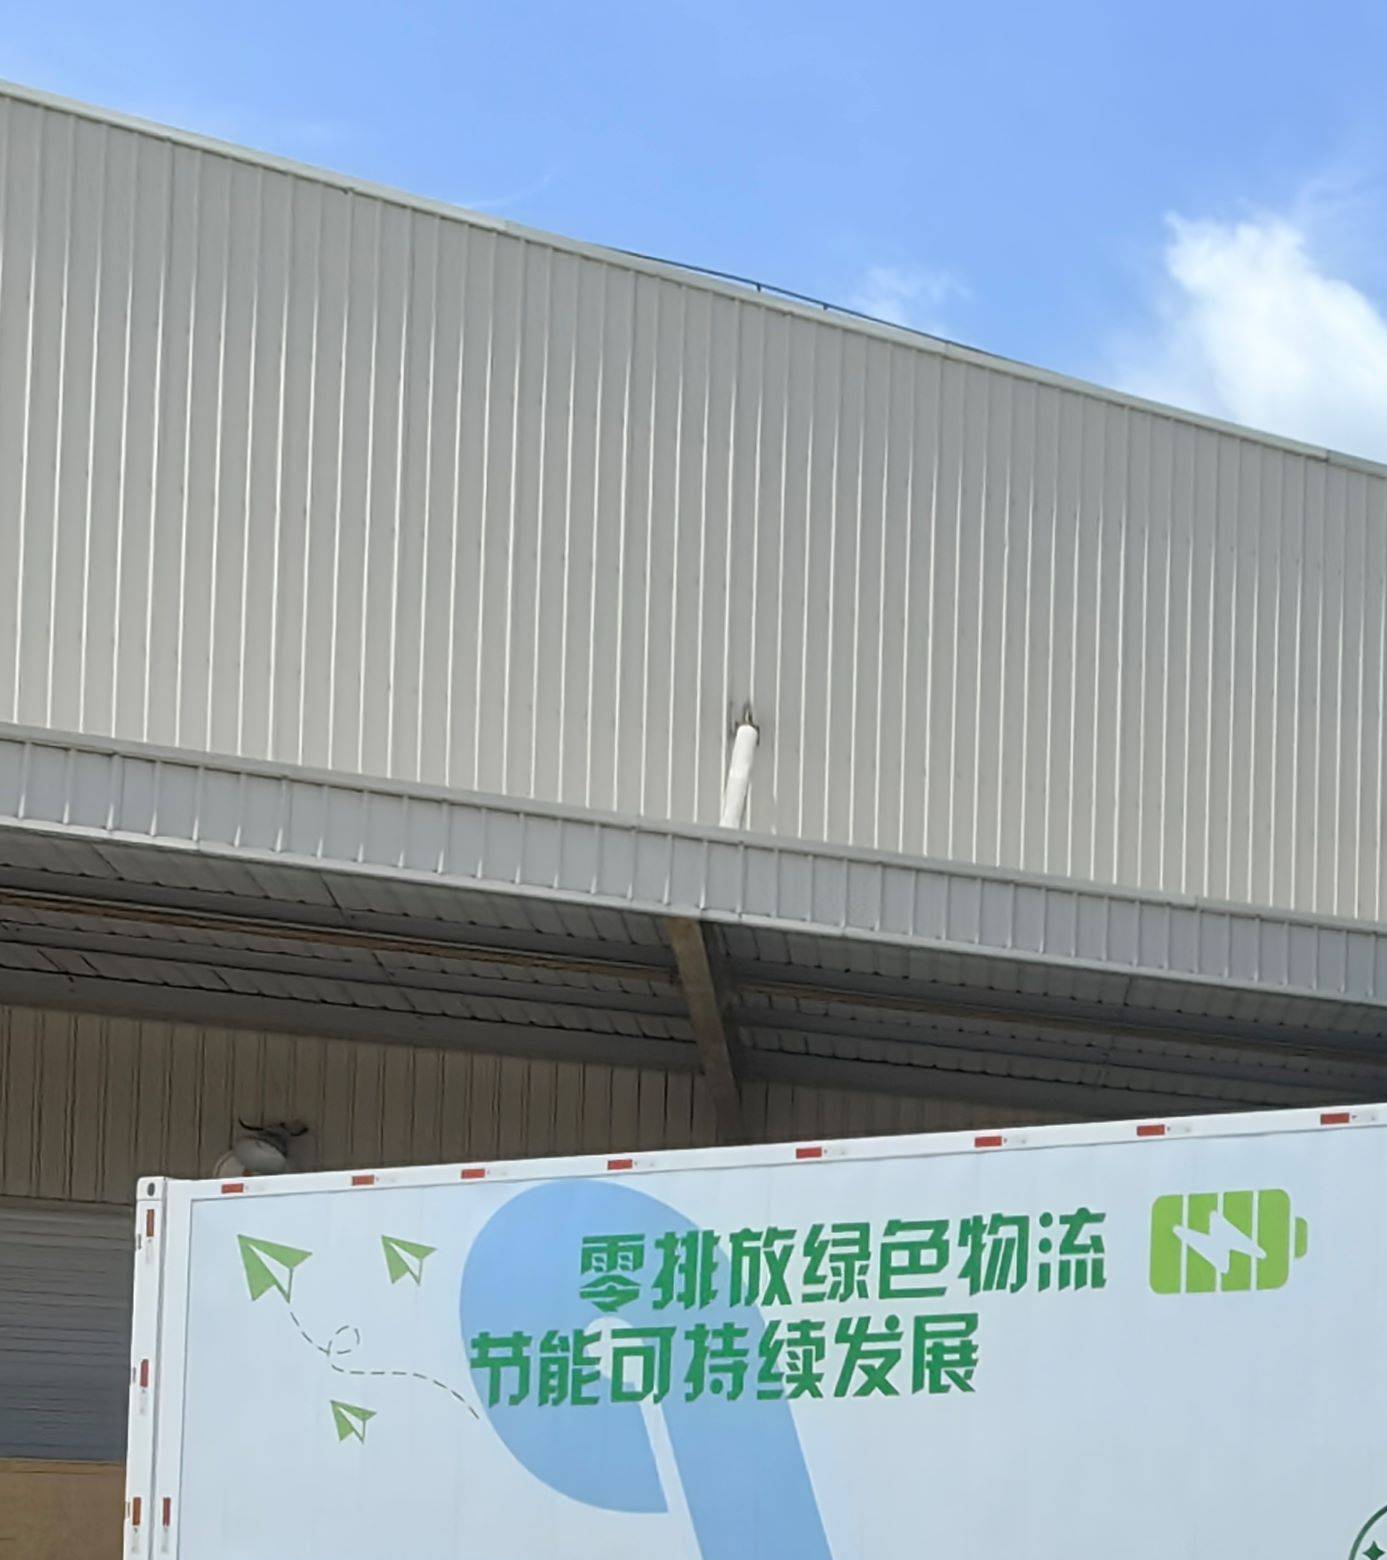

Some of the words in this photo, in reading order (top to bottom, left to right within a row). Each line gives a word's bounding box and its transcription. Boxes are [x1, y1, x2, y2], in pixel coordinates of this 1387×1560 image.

[578, 1207, 1108, 1313] 零排放绿色物流
[469, 1313, 980, 1409] 节能可持续发展
